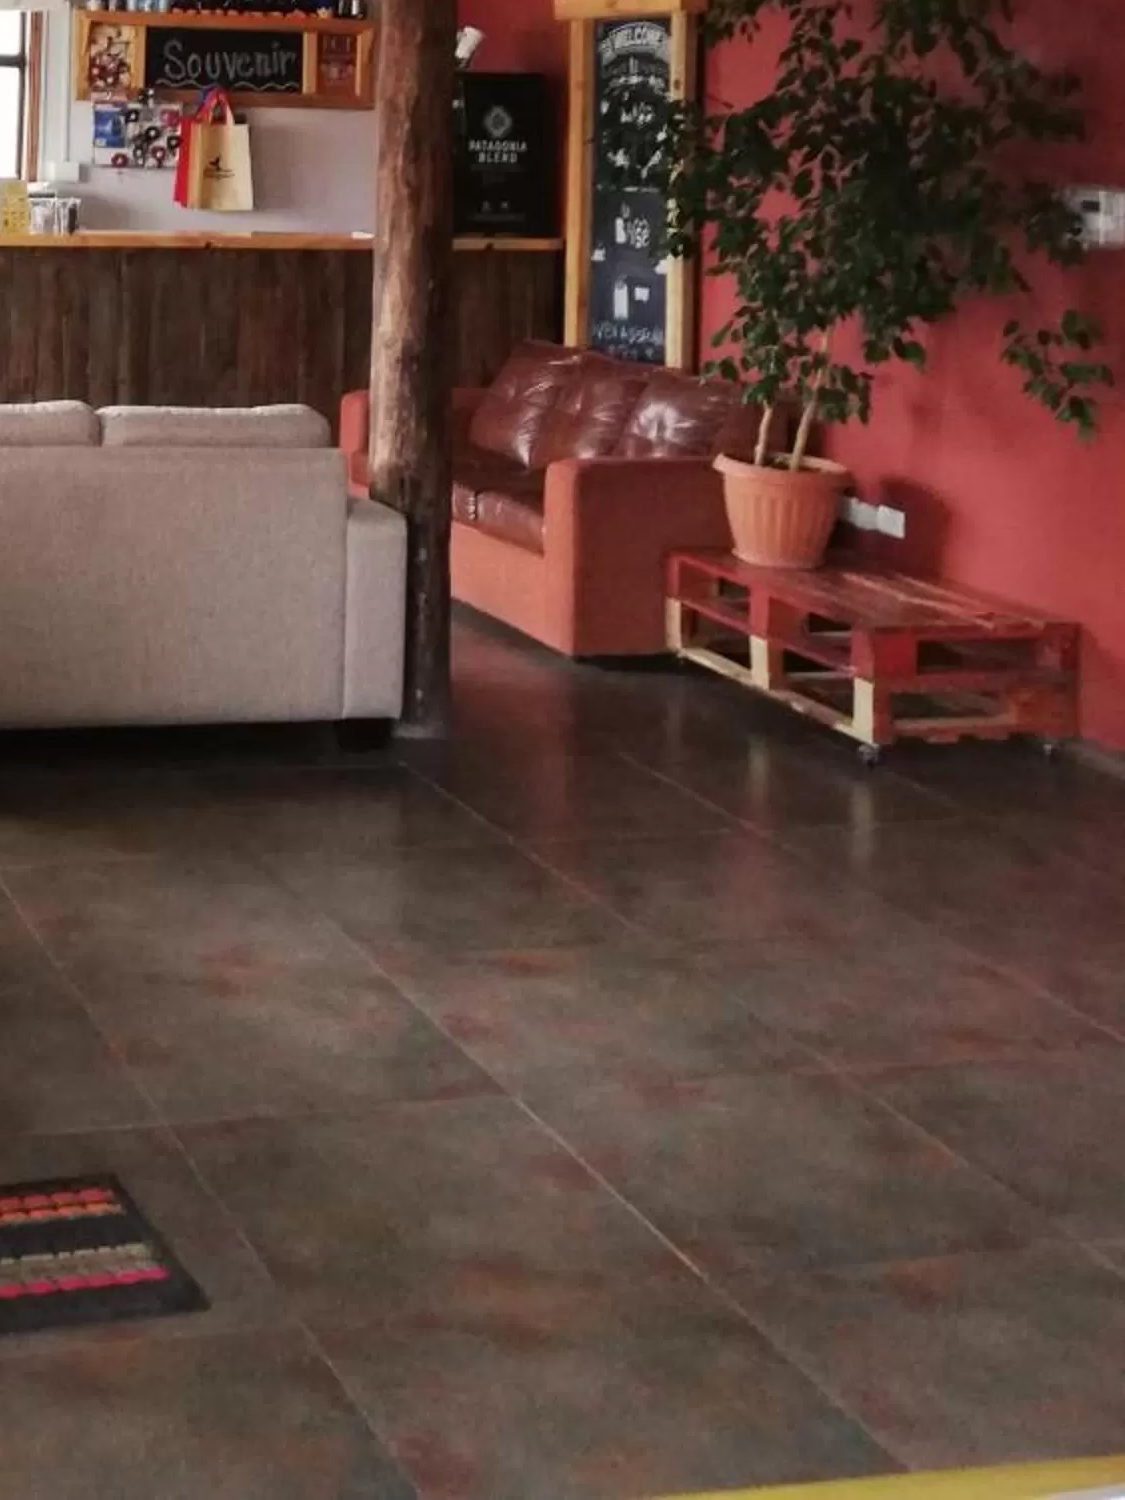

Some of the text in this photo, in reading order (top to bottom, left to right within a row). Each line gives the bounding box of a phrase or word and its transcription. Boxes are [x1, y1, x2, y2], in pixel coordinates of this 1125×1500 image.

[163, 40, 296, 80] Souvenir
[468, 140, 527, 152] PATAGONIA
[478, 152, 518, 163] BLEND
